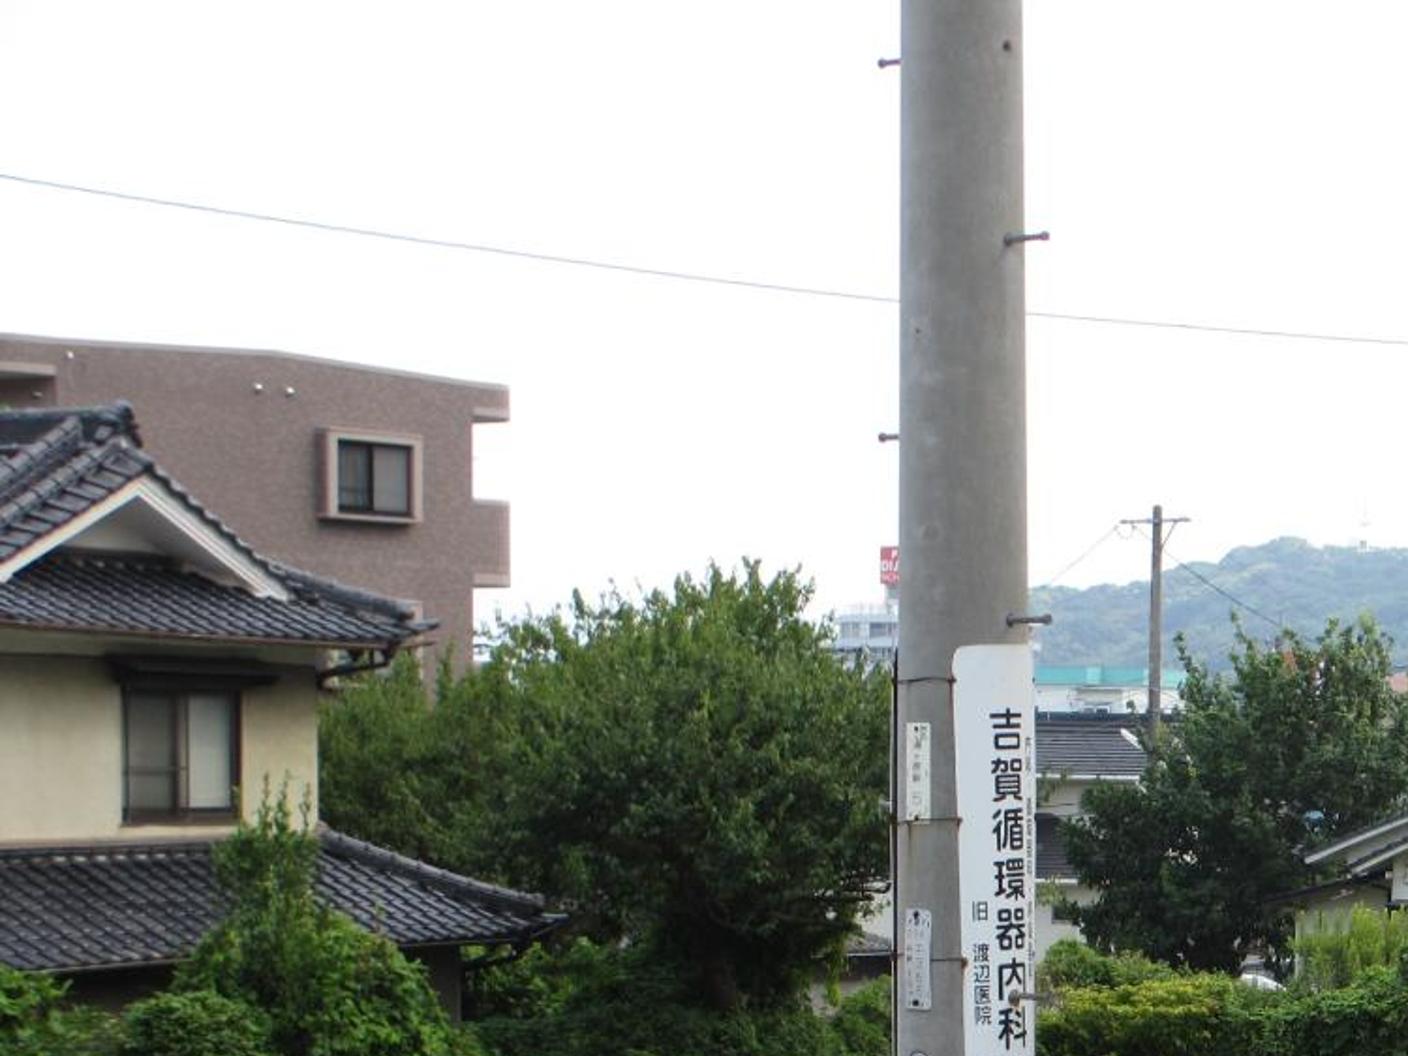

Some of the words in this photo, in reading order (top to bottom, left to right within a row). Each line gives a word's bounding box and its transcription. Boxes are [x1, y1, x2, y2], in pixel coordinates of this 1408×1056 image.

[989, 708, 1027, 1051] 吉賀循環器内科
